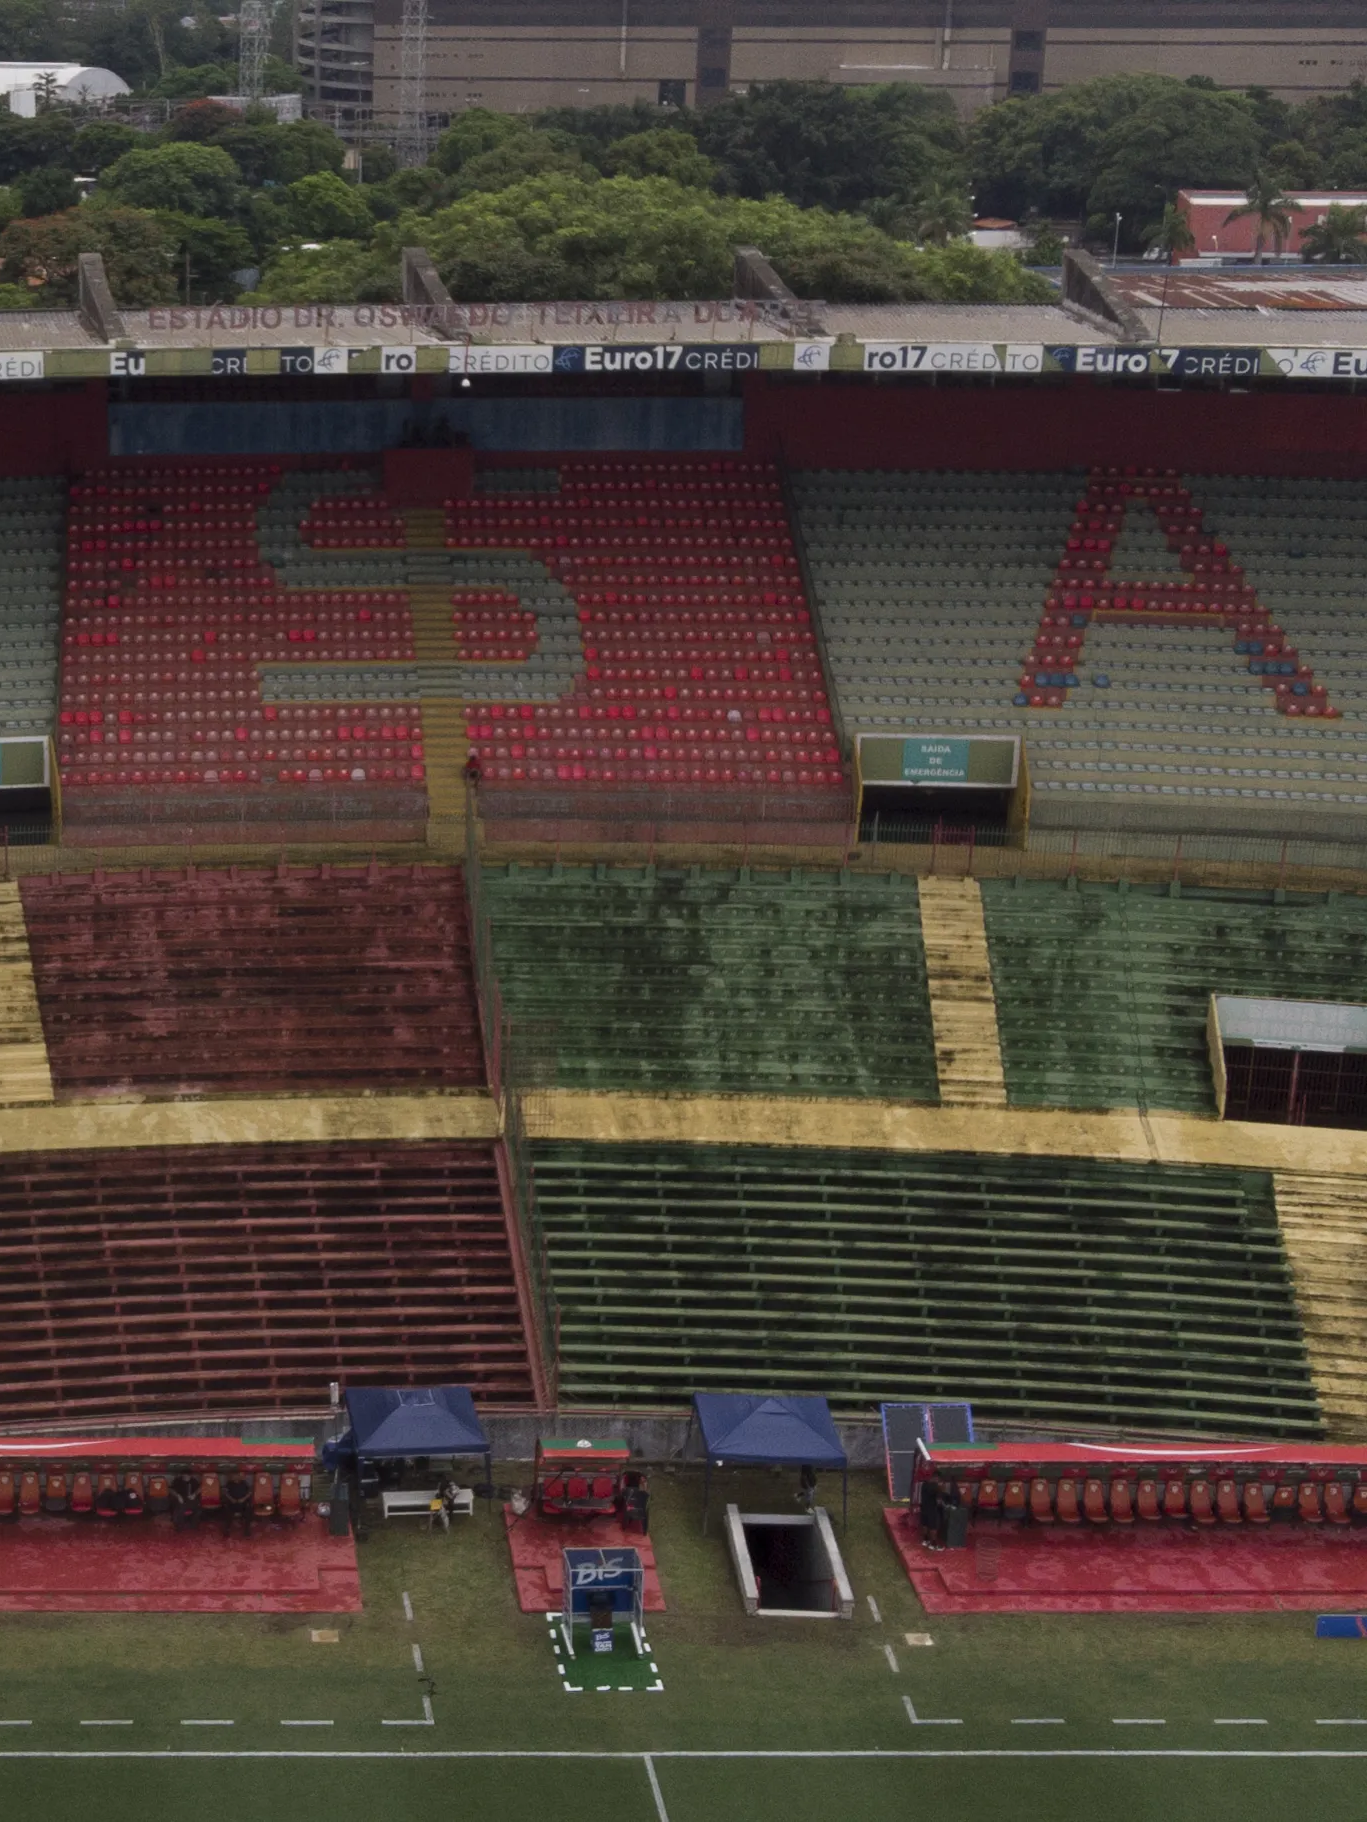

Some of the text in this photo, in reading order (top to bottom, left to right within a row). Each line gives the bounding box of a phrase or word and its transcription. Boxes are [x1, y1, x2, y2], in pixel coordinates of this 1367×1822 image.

[294, 303, 344, 328] DR.
[449, 350, 549, 371] CRÉDITO
[585, 345, 683, 370] Euro17
[931, 347, 1039, 370] CRÉDTO
[1076, 347, 1179, 373] Euro7
[929, 757, 943, 765] DE
